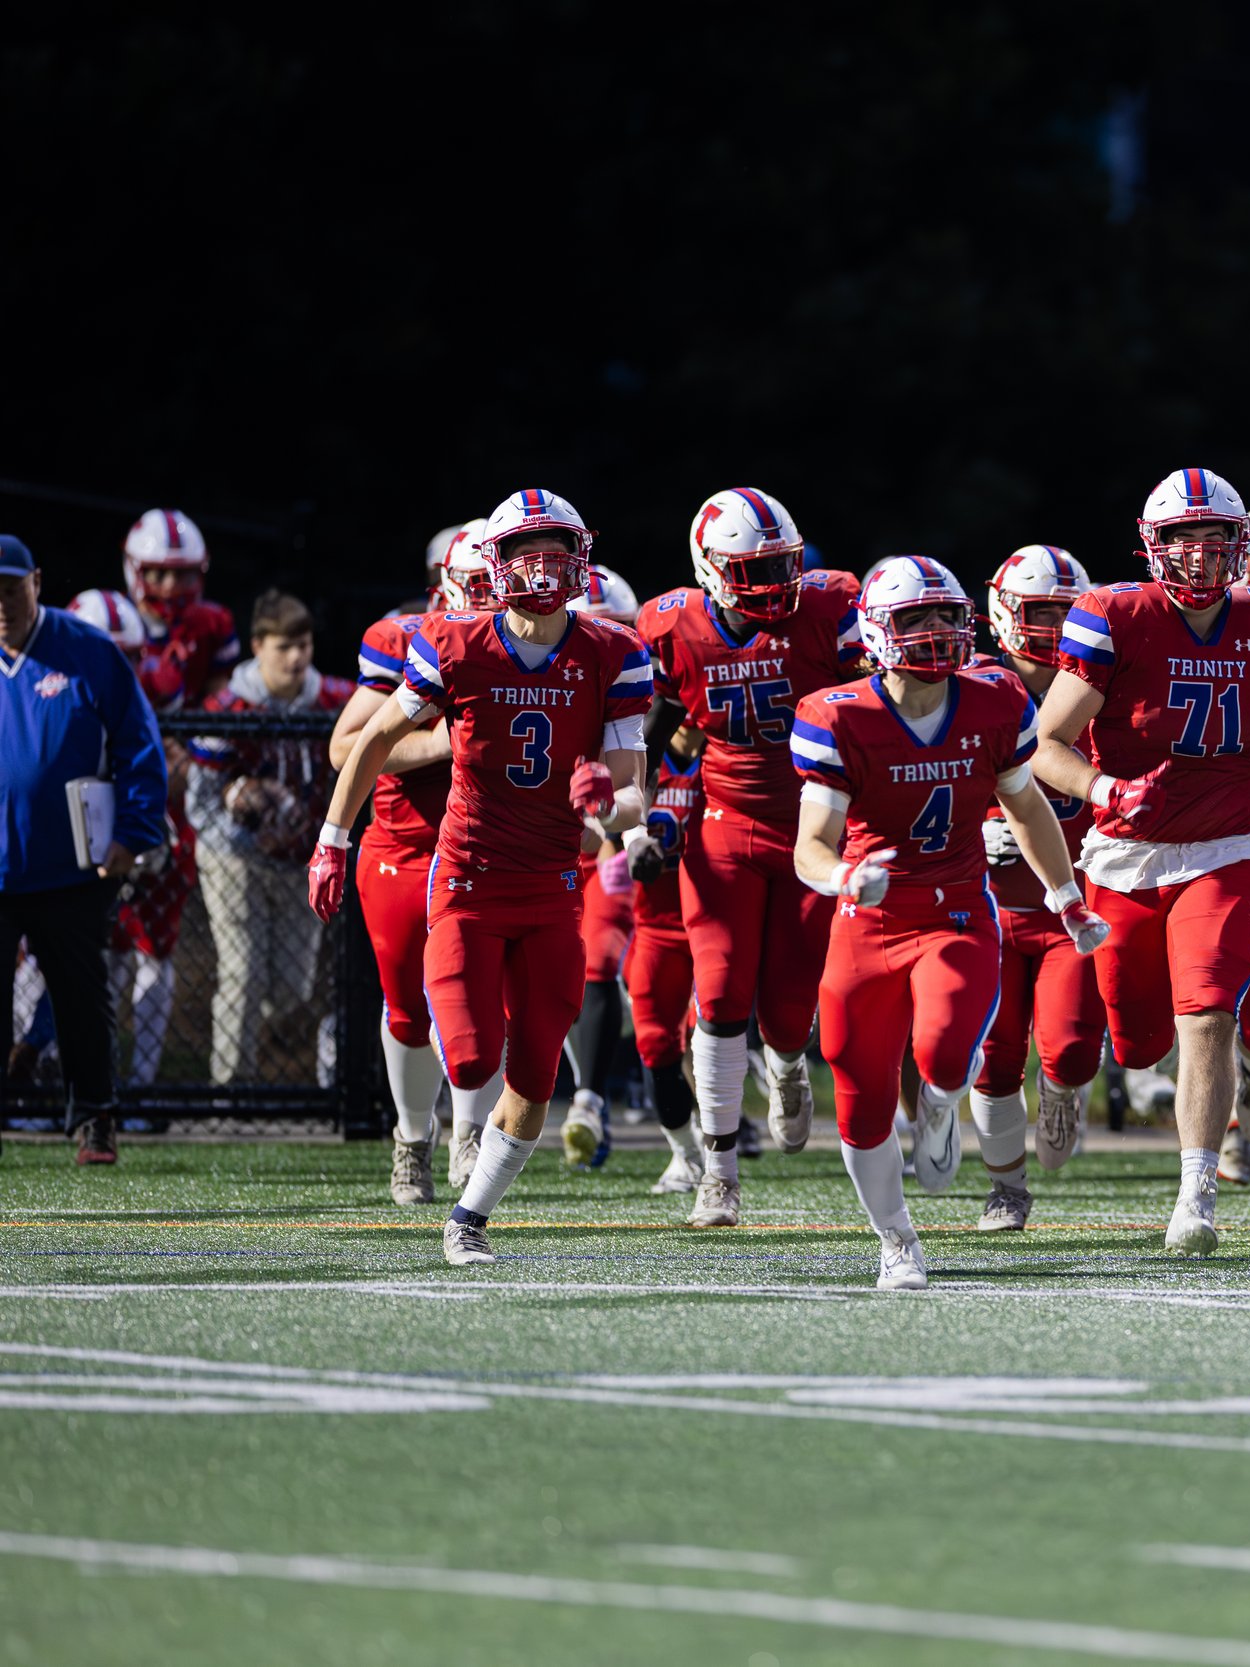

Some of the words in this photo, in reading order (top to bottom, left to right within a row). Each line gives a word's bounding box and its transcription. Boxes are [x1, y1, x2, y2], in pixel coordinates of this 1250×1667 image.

[522, 514, 552, 524] Riddell
[1185, 507, 1213, 515] Riddell
[703, 658, 784, 683] TRINITY
[1167, 657, 1247, 679] TRINITY
[490, 687, 576, 707] TRINITY
[705, 677, 796, 747] 75
[1166, 680, 1245, 759] 71
[505, 710, 553, 790] 3
[889, 758, 975, 784] TRINITY
[909, 783, 954, 854] 4
